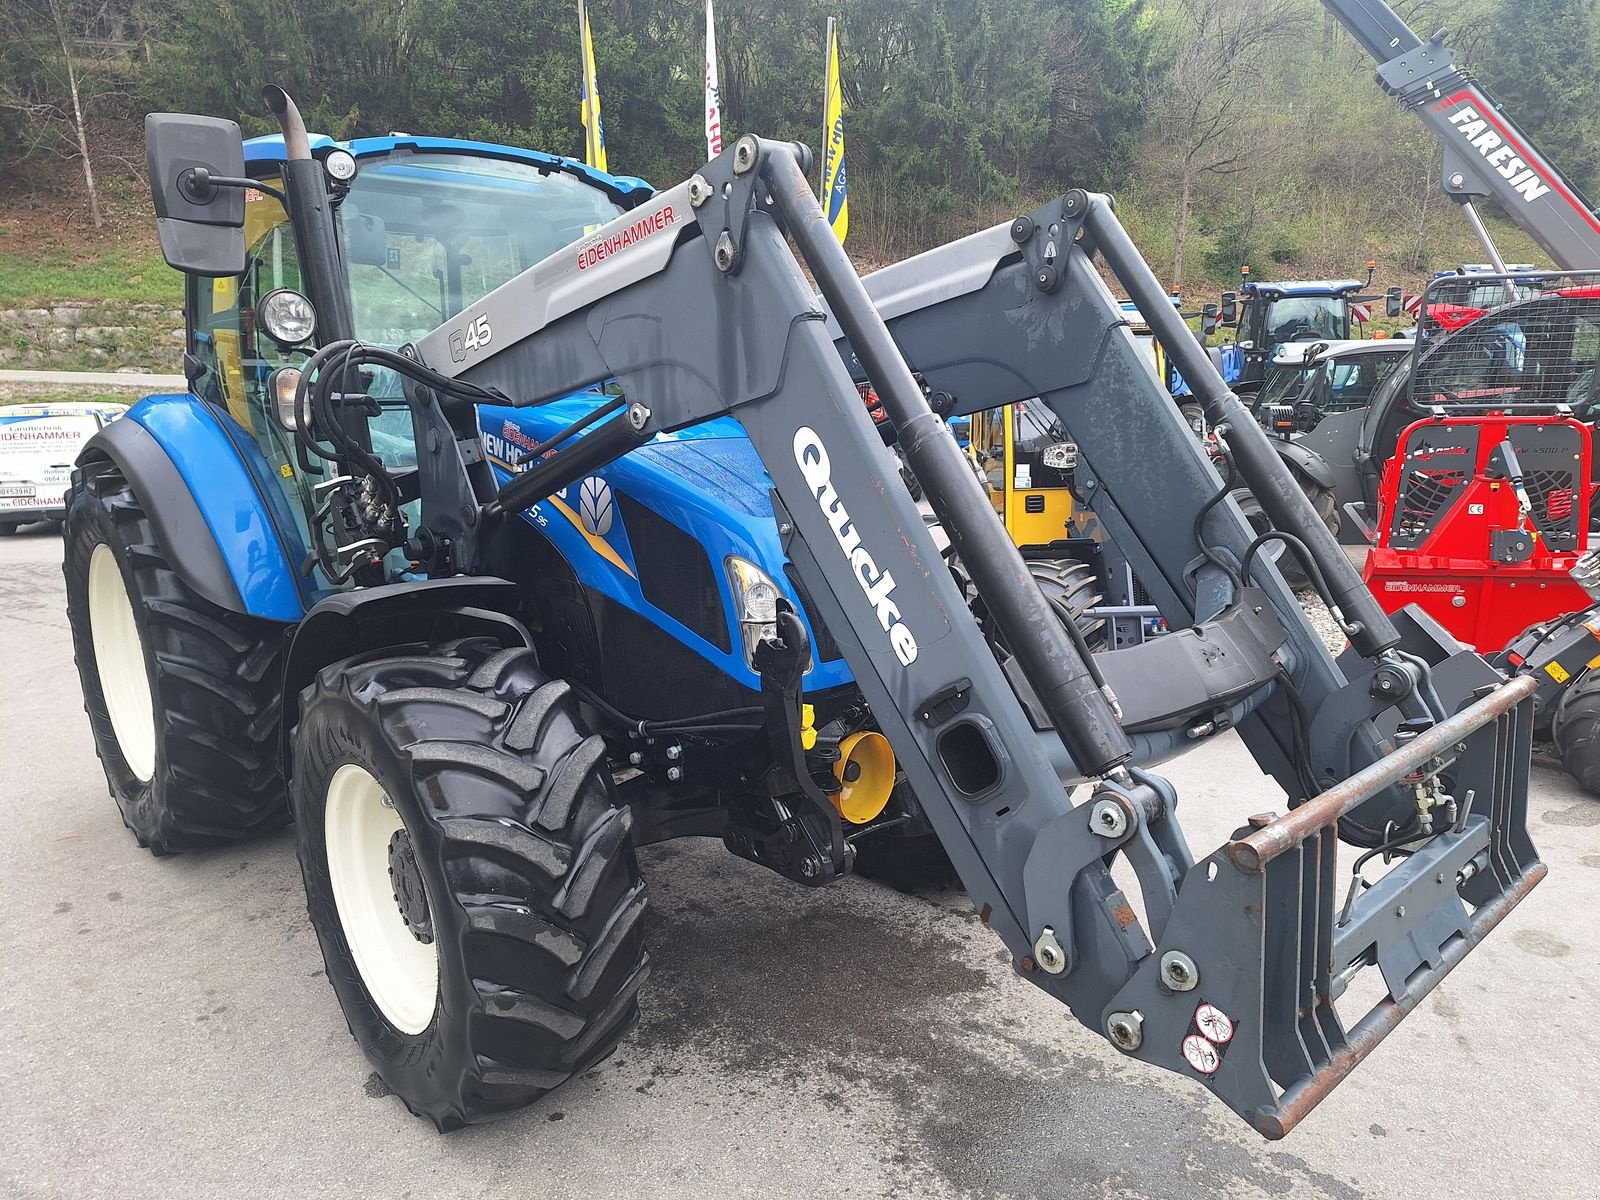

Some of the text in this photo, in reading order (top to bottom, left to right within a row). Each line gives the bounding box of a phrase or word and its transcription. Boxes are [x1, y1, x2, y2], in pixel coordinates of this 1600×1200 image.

[1448, 106, 1551, 203] FARESIN
[577, 205, 675, 271] EIDENHAMMER
[448, 312, 492, 364] Q45
[793, 426, 919, 668] Quicke
[1384, 583, 1461, 593] EIDENHAMMER
